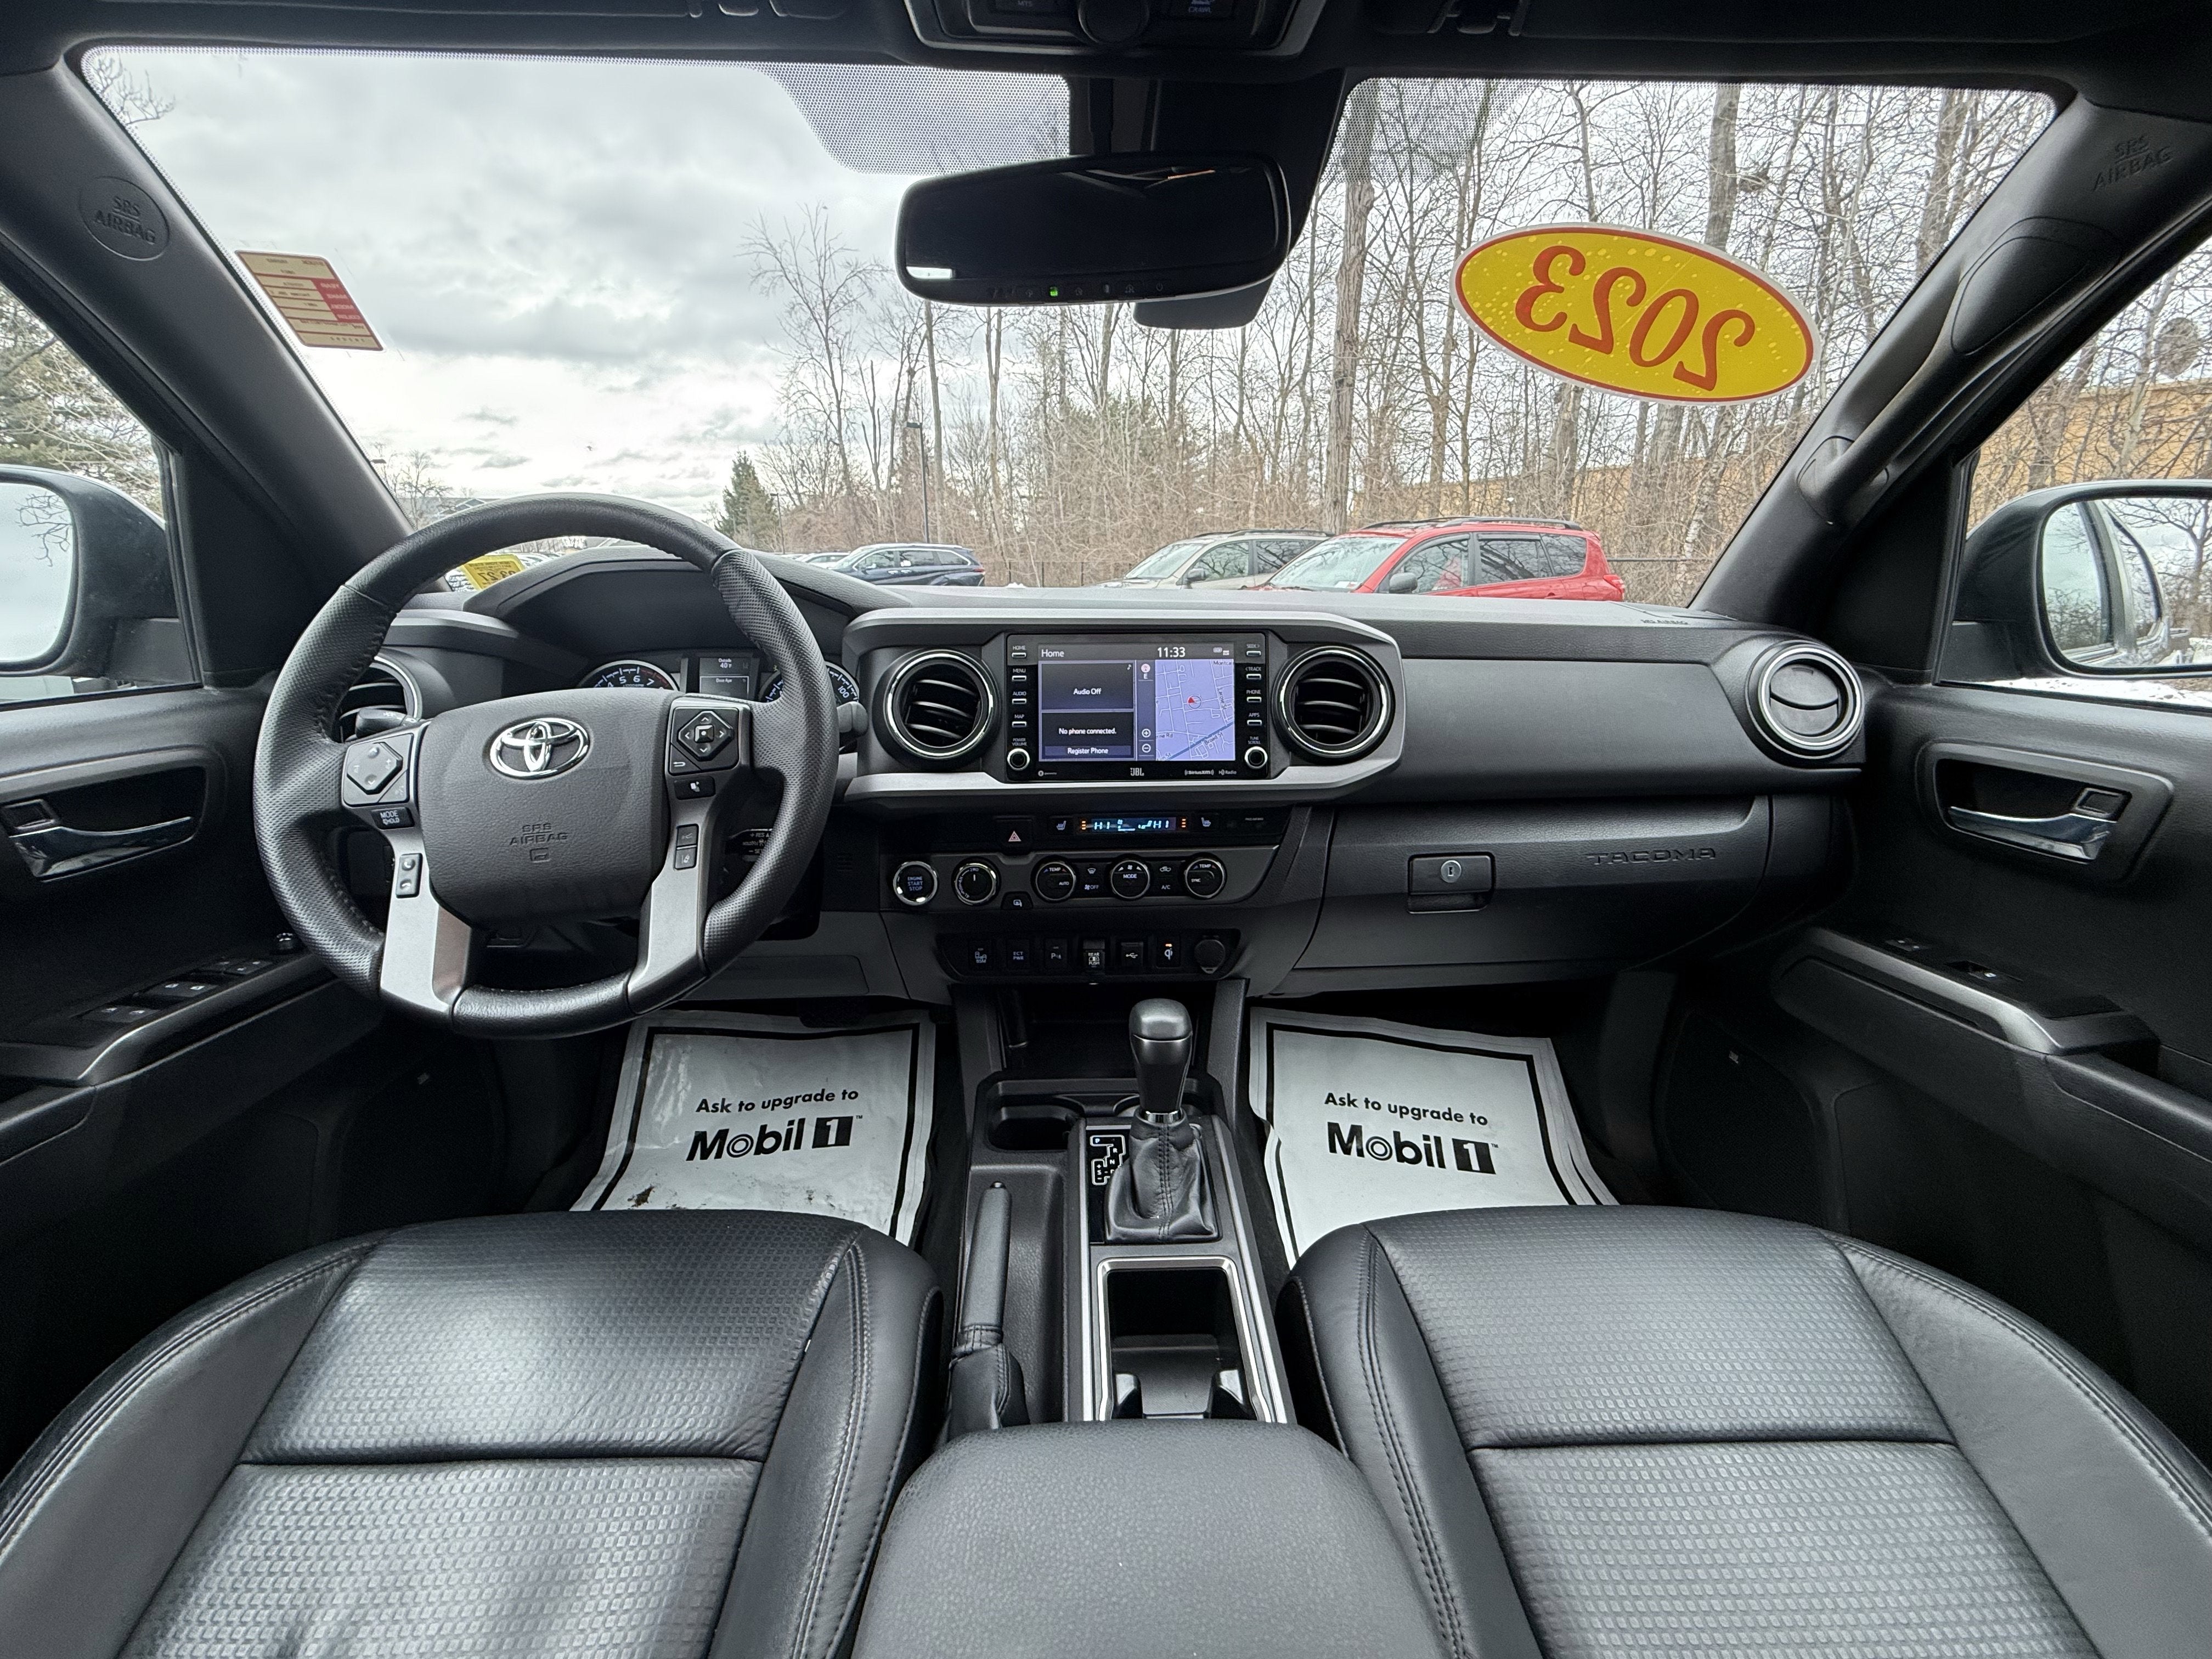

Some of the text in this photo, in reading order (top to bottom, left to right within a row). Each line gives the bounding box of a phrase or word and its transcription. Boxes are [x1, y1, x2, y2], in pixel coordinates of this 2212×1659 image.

[1041, 649, 1065, 657] Home
[1157, 646, 1186, 658] 11:33
[619, 676, 627, 684] 5
[838, 686, 850, 698] 100
[1068, 747, 1090, 755] Register
[1130, 768, 1144, 776] JBL
[380, 810, 399, 819] MODE
[522, 823, 552, 834] SRS
[509, 832, 569, 847] AIRBAG
[1585, 848, 1716, 865] TACOMA
[696, 1088, 859, 1113] Ask to upgrade to
[1324, 1092, 1488, 1126] Ask to upgrade to
[686, 1118, 806, 1161] Mobil
[1327, 1121, 1446, 1169] Mobil
